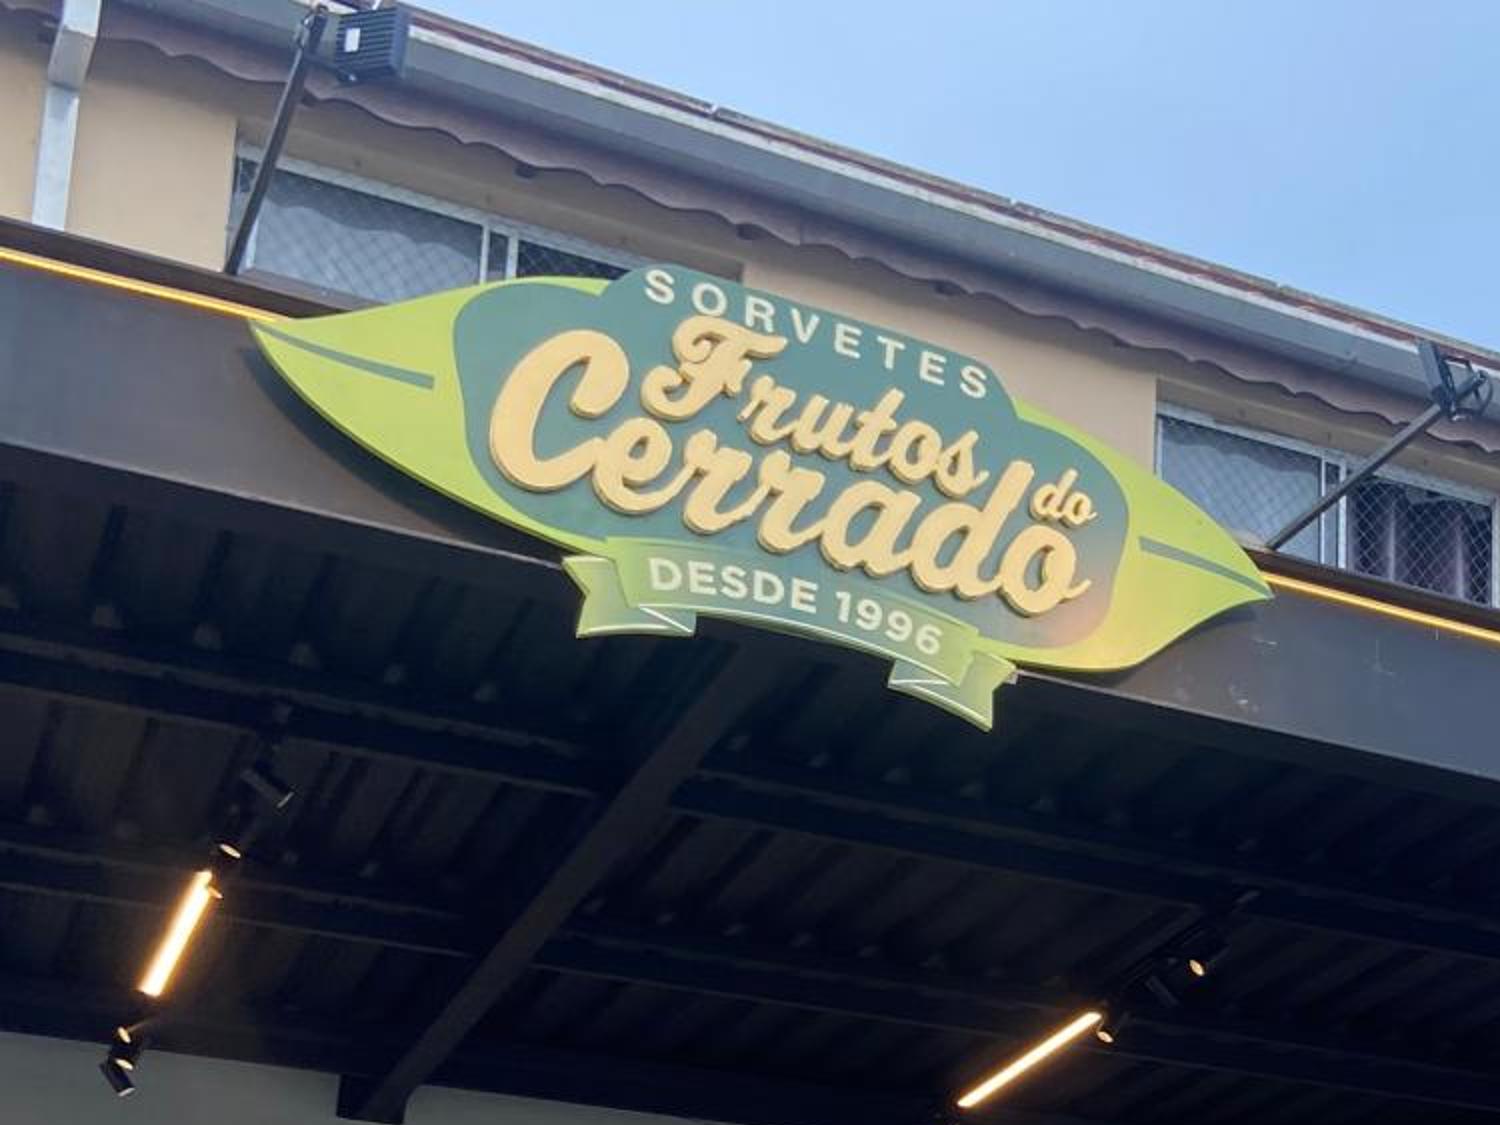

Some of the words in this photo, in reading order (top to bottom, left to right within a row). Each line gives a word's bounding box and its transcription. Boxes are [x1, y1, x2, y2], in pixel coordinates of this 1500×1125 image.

[643, 268, 988, 400] SORVETES
[488, 328, 1093, 618] Cerrado
[640, 314, 990, 497] Frutos
[1029, 468, 1097, 527] do
[648, 556, 819, 615] DESDE
[834, 591, 943, 656] 1996
